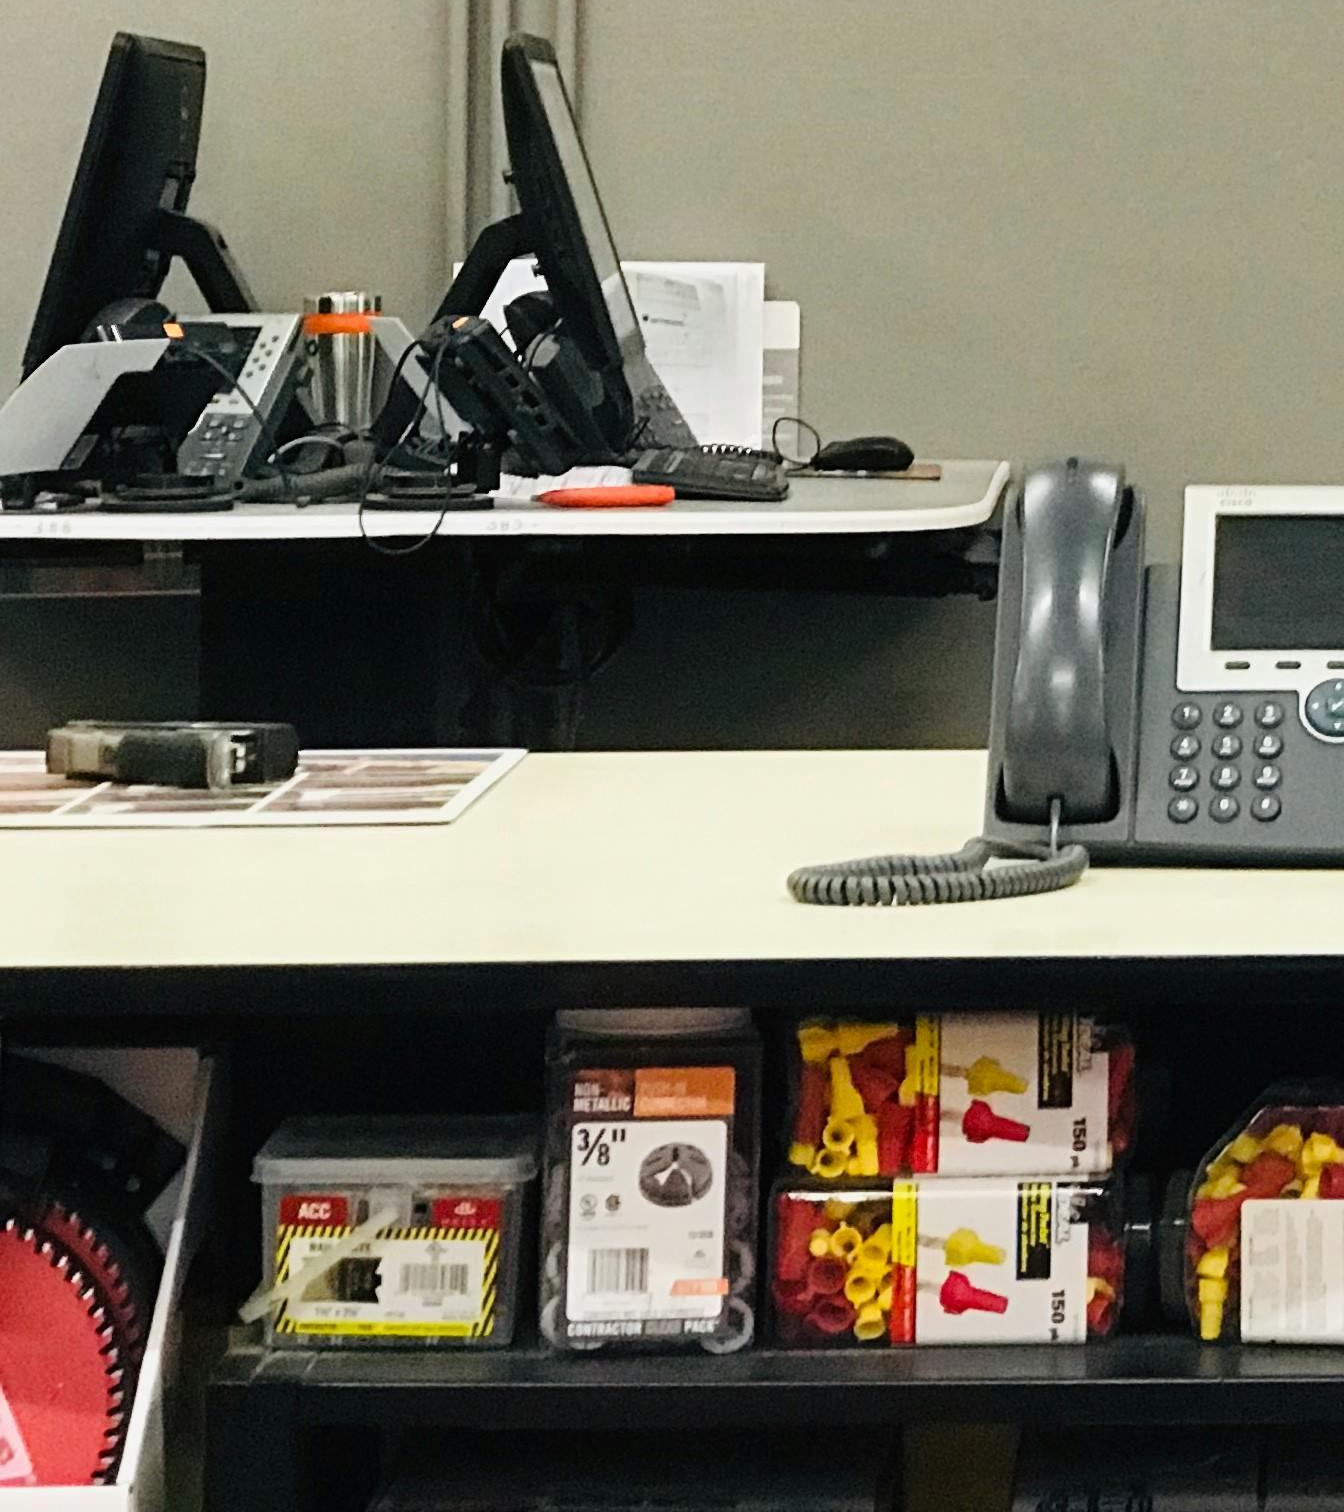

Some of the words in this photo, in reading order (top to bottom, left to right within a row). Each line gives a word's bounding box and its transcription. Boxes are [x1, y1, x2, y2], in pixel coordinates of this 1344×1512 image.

[573, 1096, 632, 1113] METALLIC
[1072, 1117, 1087, 1151] 150
[1051, 1289, 1066, 1324] 150
[567, 1321, 643, 1337] CONTRACTOR
